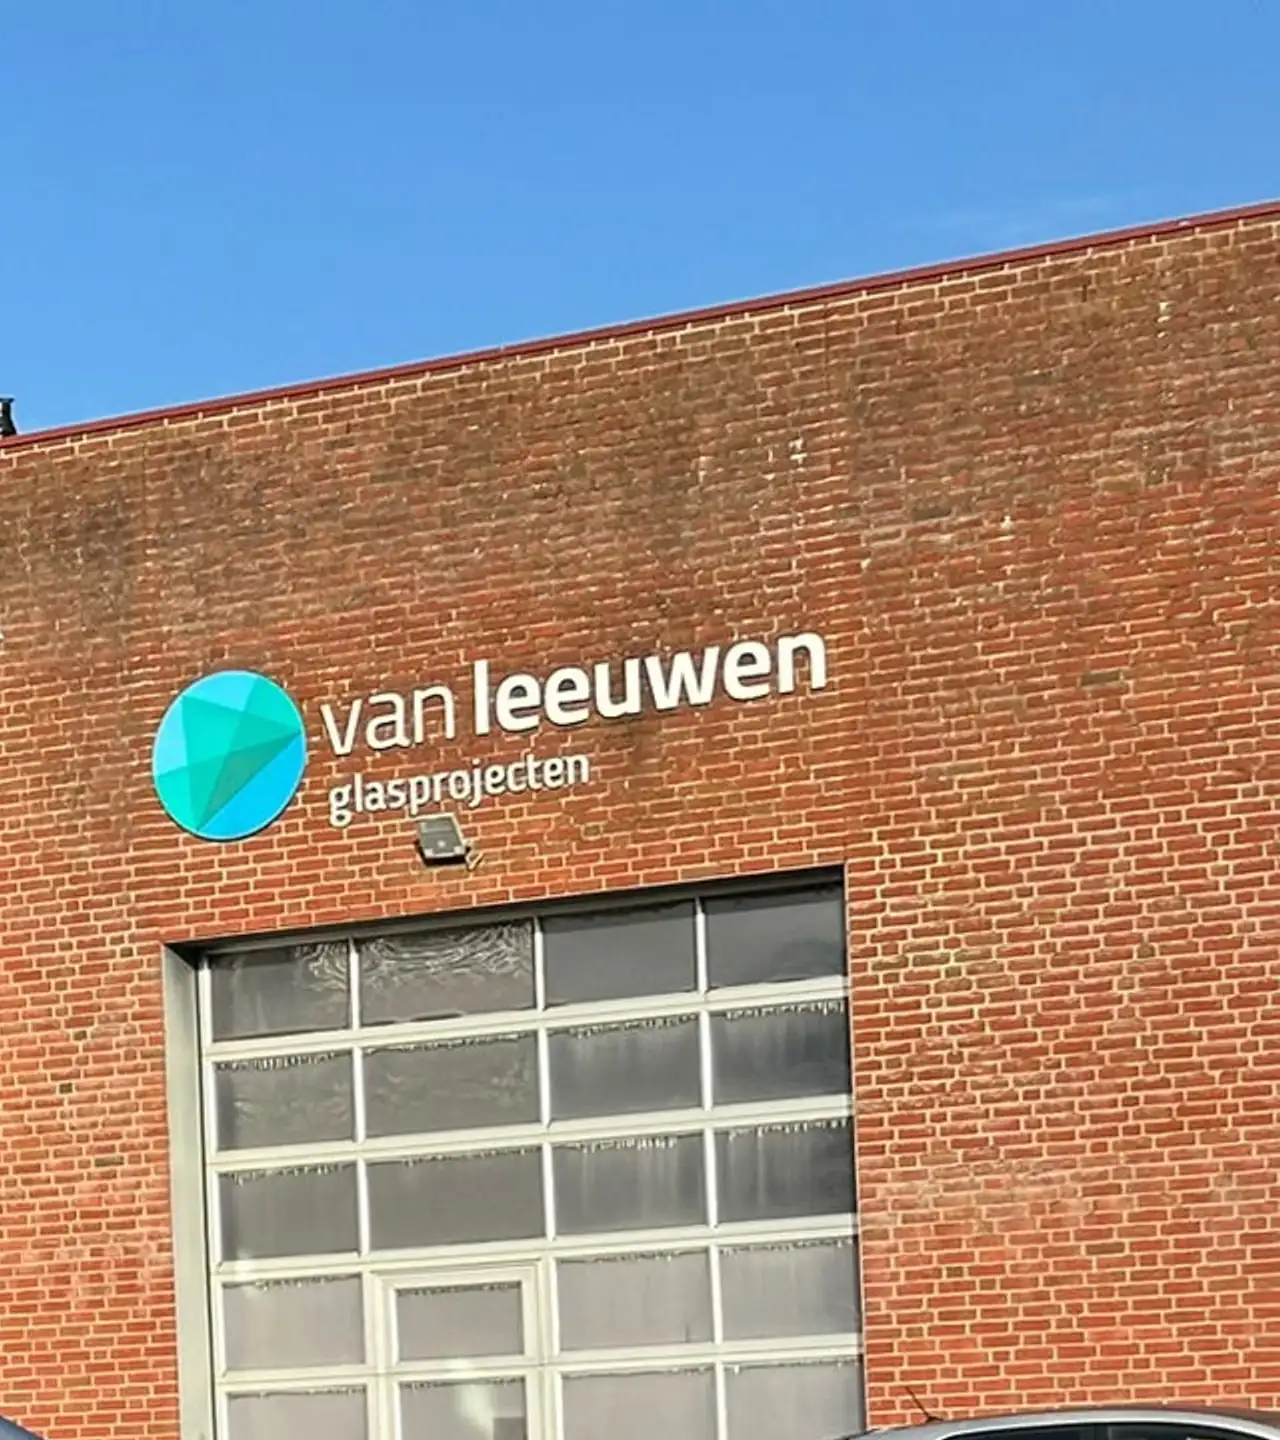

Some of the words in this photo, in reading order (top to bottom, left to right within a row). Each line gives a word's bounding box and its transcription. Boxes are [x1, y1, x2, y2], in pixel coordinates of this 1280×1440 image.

[320, 685, 455, 756] van
[472, 631, 827, 736] leeuwen
[329, 753, 591, 827] glasprojecten
